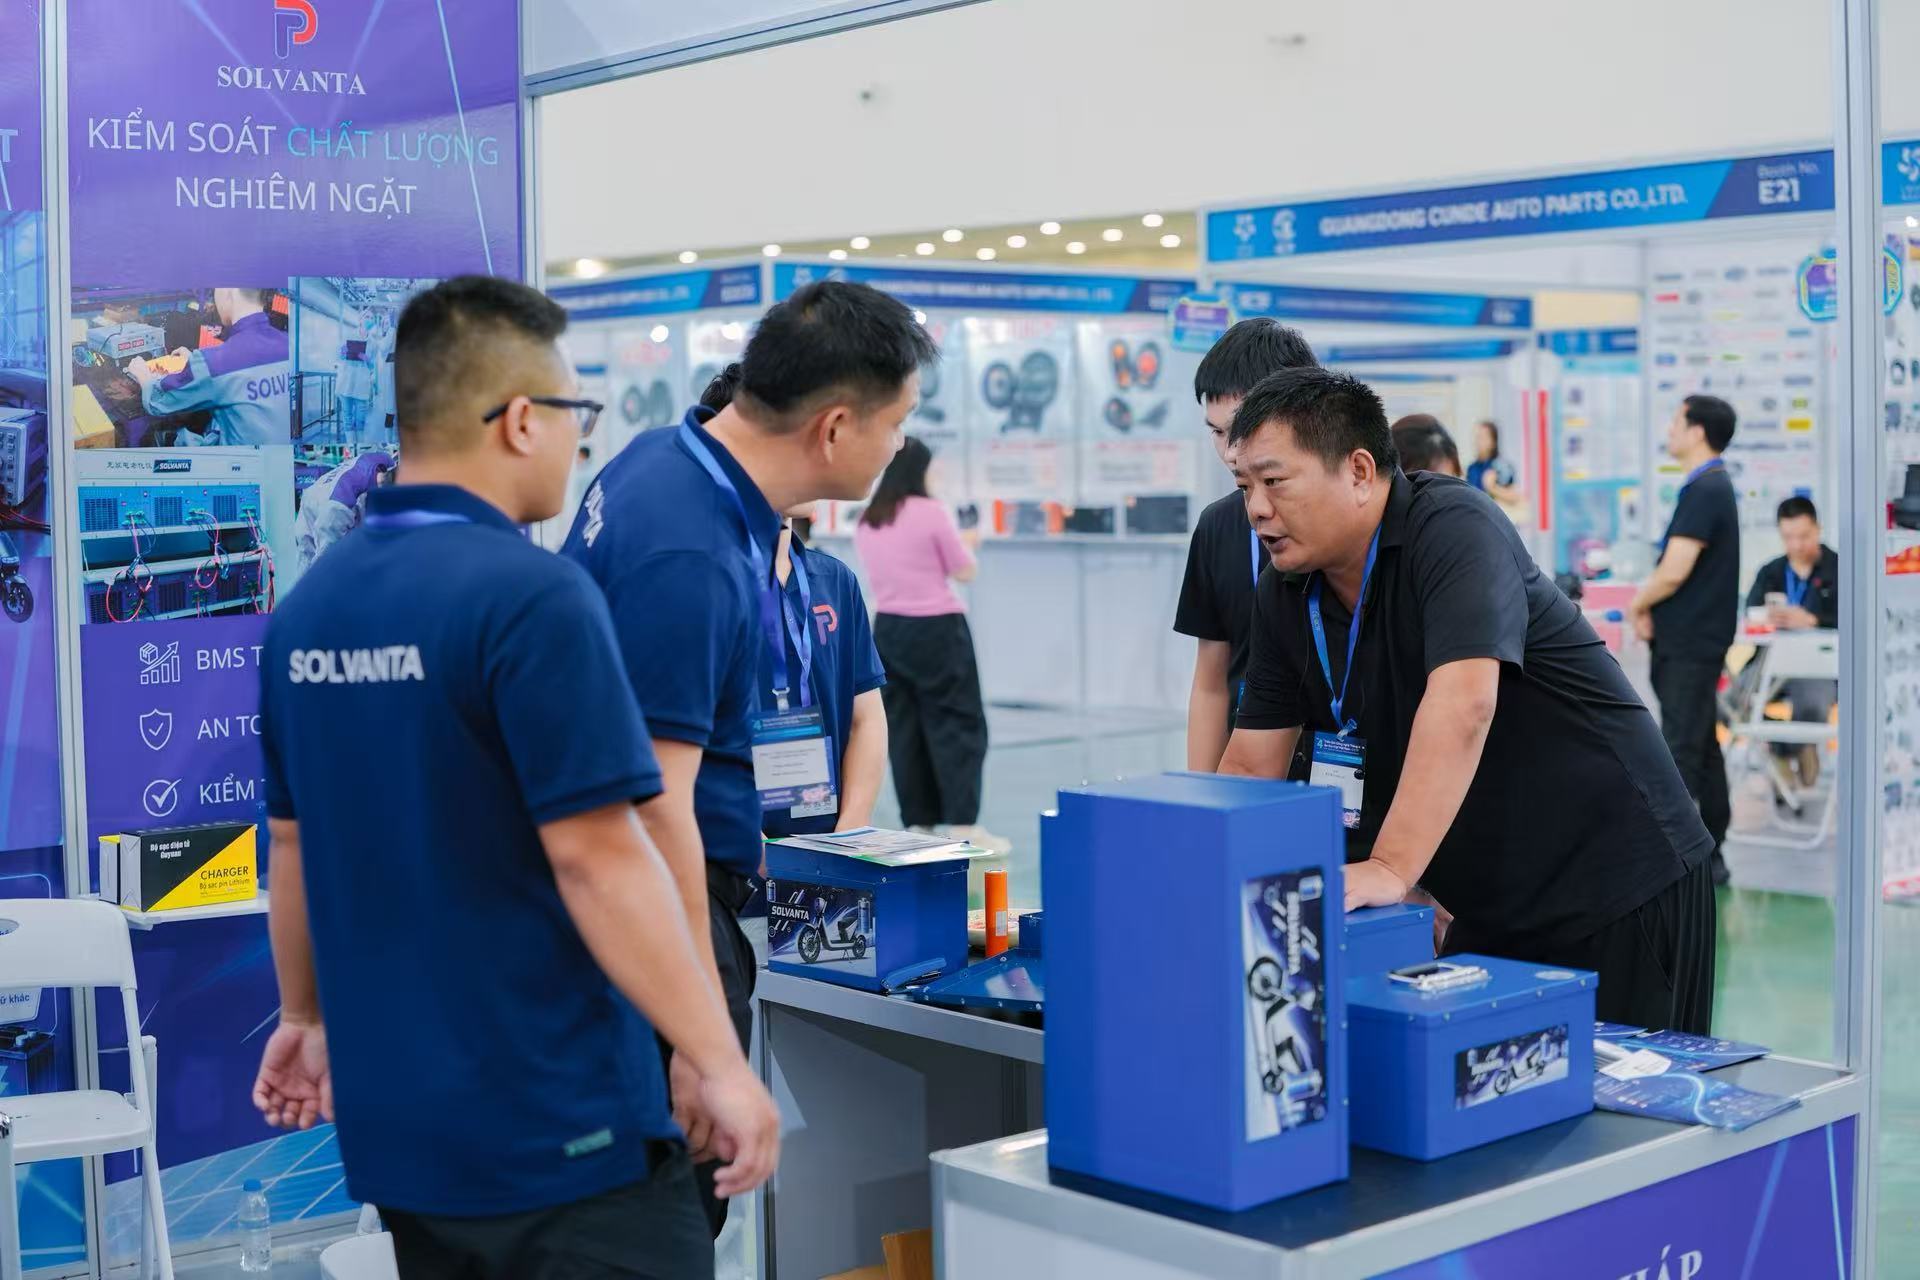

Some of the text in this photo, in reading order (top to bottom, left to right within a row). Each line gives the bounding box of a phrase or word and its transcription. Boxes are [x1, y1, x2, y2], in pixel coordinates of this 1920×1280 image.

[216, 65, 367, 95] SOLVANTA
[0, 128, 19, 162] T
[87, 107, 499, 168] KIỂM SOÁT CHẤT LƯỢNG
[175, 171, 417, 219] NGHIÊM NGẶT
[1491, 195, 1542, 222] AUTO
[1545, 190, 1607, 216] PARTS
[1758, 177, 1800, 205] E21
[159, 462, 189, 470] SOLVANTA
[197, 645, 264, 670] BMS T
[288, 645, 425, 684] SOLVANTA
[197, 717, 229, 740] AN
[200, 773, 255, 805] KIỂM
[200, 866, 249, 880] CHARGER
[771, 905, 810, 920] SOLVANTA
